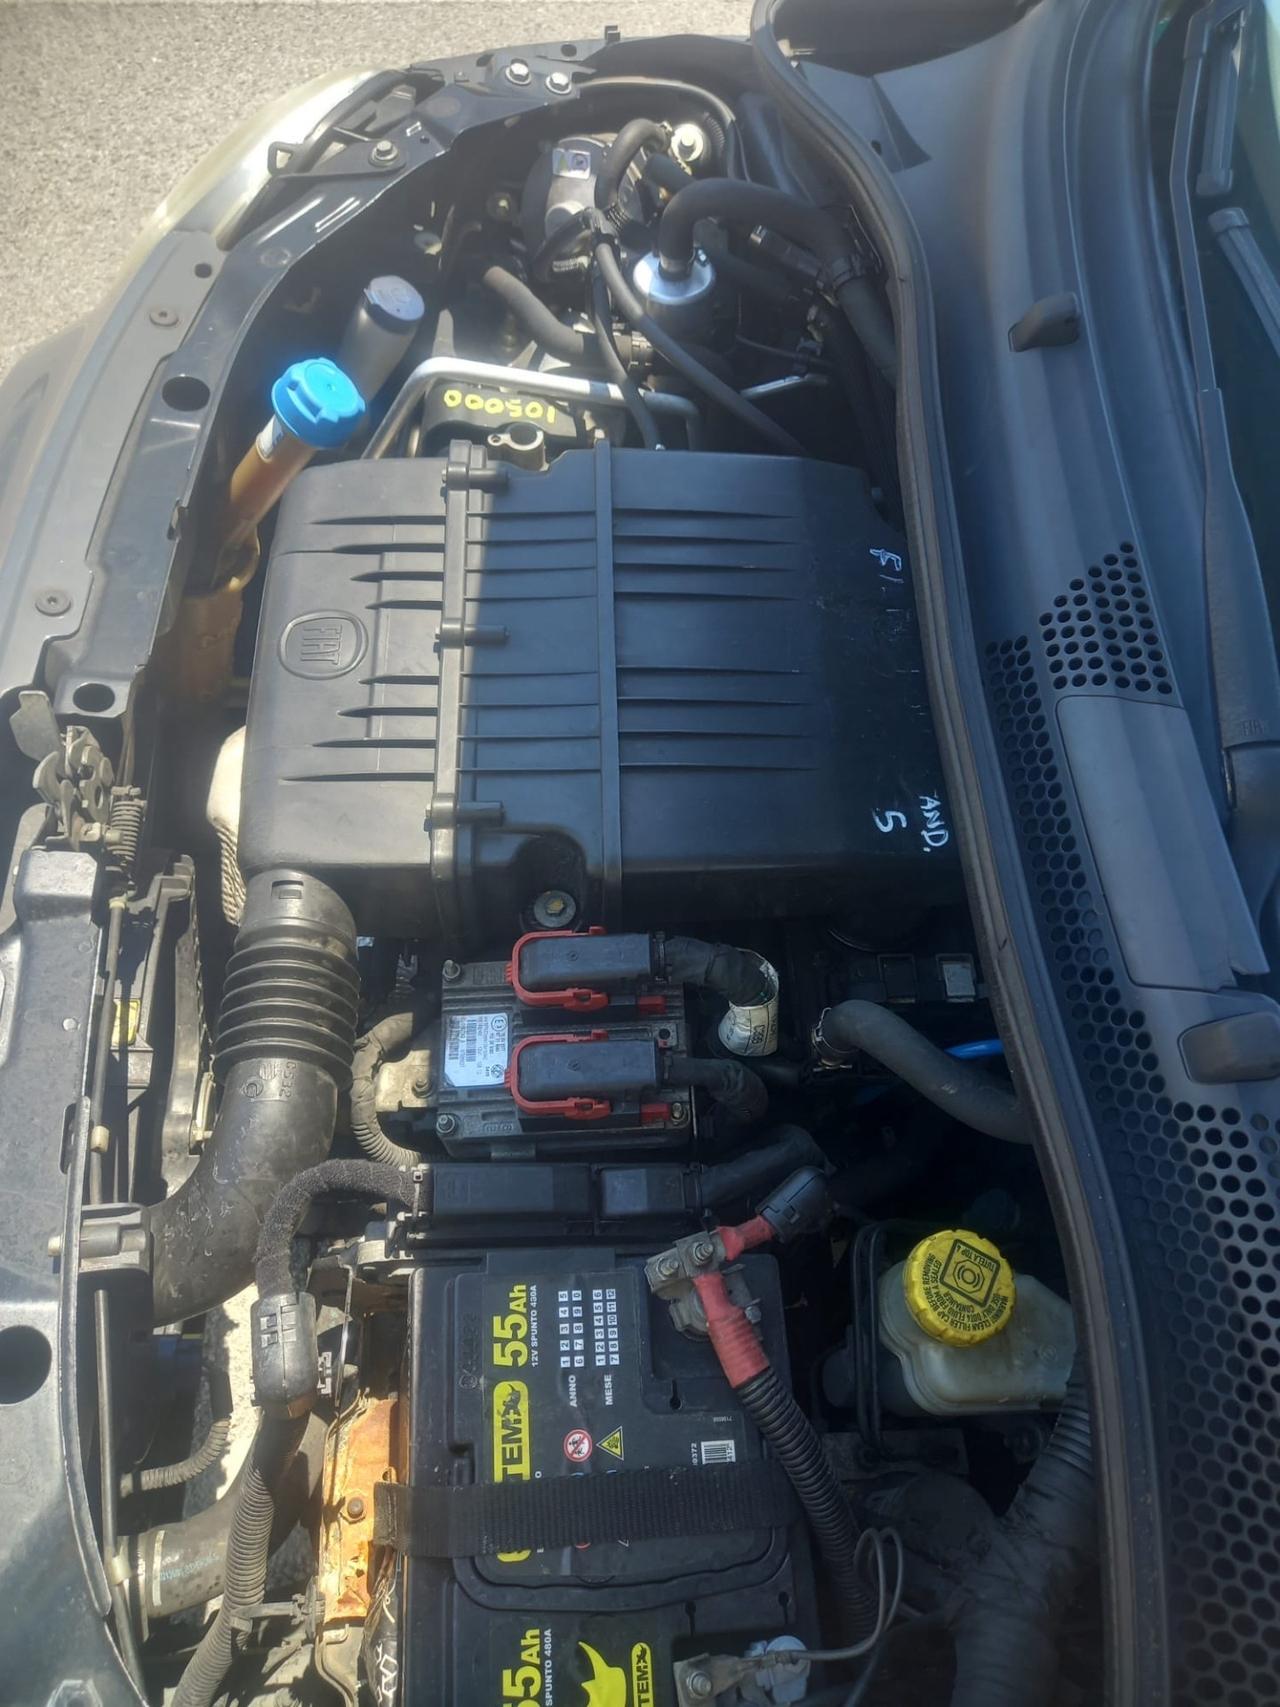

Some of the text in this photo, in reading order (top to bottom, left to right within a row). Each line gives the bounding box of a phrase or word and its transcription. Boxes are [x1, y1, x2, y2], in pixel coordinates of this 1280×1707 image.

[443, 389, 556, 424] 105000
[300, 624, 343, 666] FIAT
[873, 810, 907, 833] 5
[961, 1248, 972, 1259] TOP
[973, 1253, 994, 1271] TUTELA
[930, 1259, 942, 1283] SEALED
[923, 1286, 940, 1311] BEFORE
[943, 1292, 974, 1312] CONTAINER
[936, 1310, 949, 1322] CAP
[946, 1307, 965, 1320] FLUID
[949, 1319, 970, 1331] FILLER
[493, 1284, 528, 1367] 55Ah
[530, 1310, 539, 1348] SPUNTO
[971, 1321, 991, 1330] CLEAN
[530, 1350, 539, 1368] 12V
[568, 1374, 578, 1408] ANNO
[604, 1374, 613, 1406] MESE
[544, 1659, 554, 1706] SPUNTO
